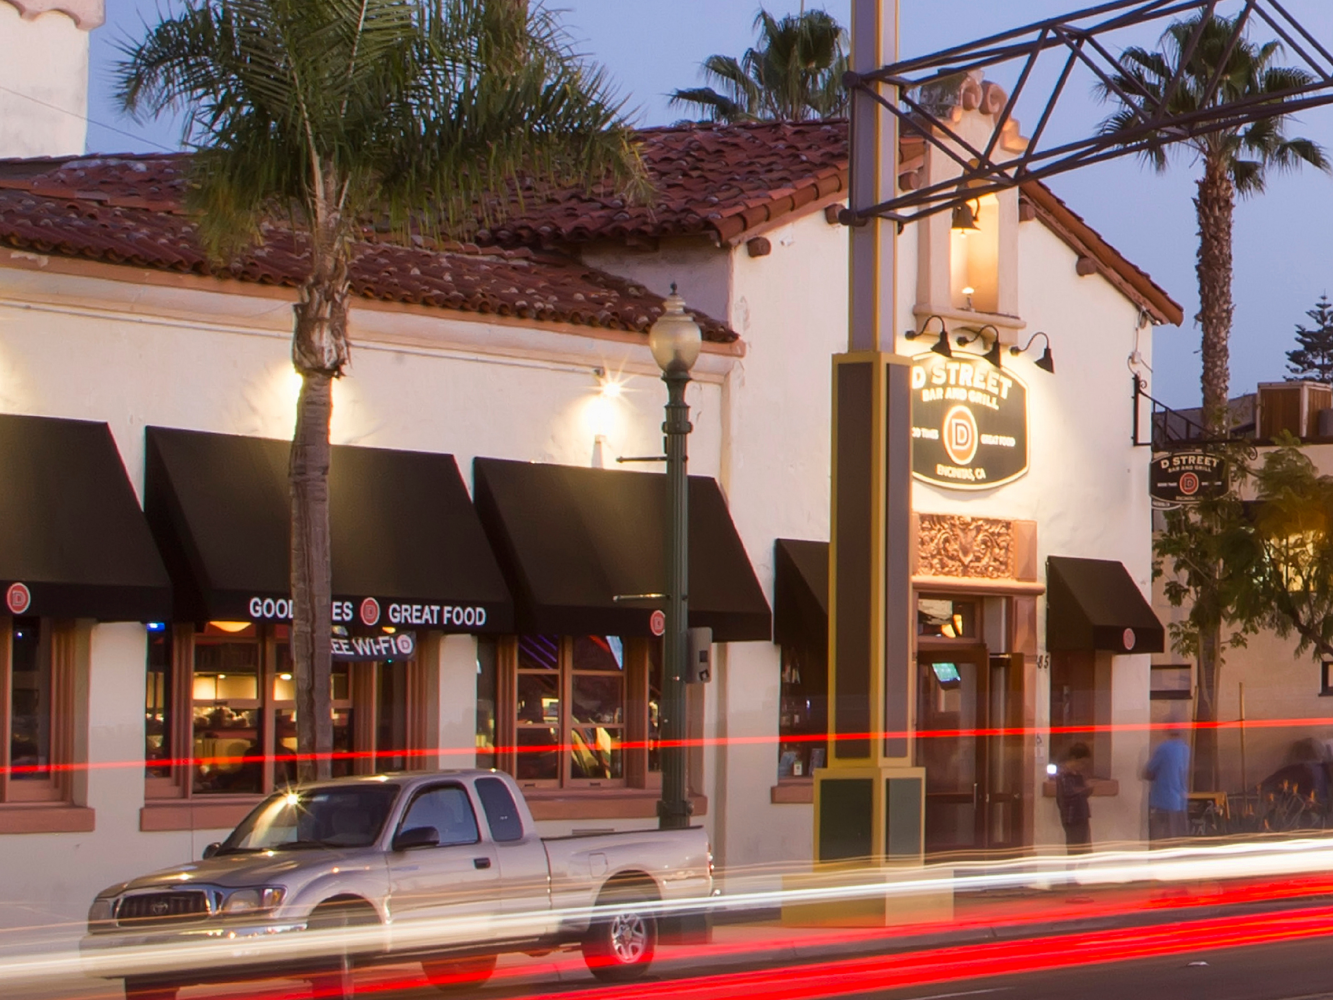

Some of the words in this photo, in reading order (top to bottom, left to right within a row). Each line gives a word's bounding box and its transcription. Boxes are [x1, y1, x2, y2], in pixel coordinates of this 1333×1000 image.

[911, 365, 926, 389] D
[931, 361, 1013, 399] STREET
[922, 387, 943, 402] BAR
[945, 386, 967, 401] AND
[968, 389, 1000, 411] GRILL
[1161, 459, 1170, 469] D
[1172, 455, 1219, 468] STREET
[388, 603, 440, 625] GREAT
[442, 606, 487, 626] FOOD
[352, 636, 397, 657] WI-FI
